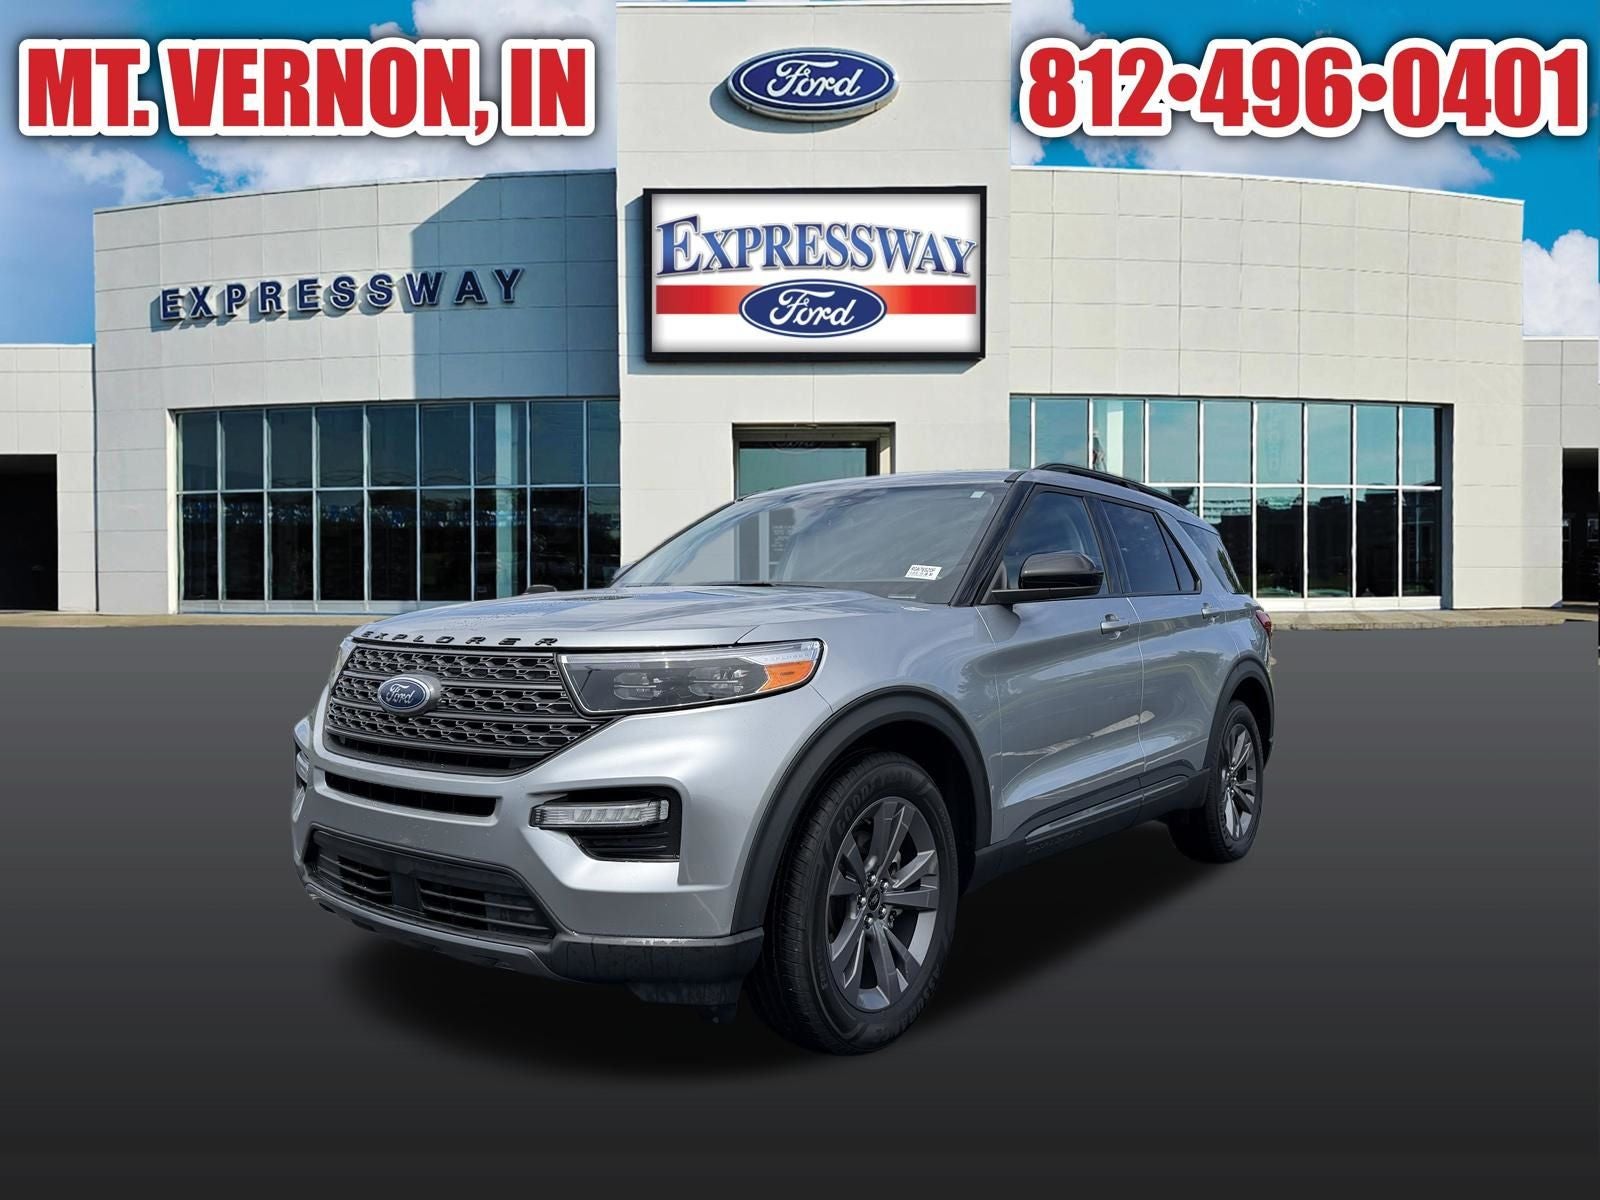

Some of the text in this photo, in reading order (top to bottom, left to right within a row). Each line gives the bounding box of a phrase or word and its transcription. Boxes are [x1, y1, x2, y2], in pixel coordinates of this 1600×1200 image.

[766, 59, 864, 97] Ford
[656, 214, 977, 276] EXPRESSWAY
[160, 268, 525, 320] EXPRESSWAY
[769, 288, 857, 326] Ford
[361, 630, 559, 647] EXPLORER
[386, 683, 415, 704] Ford
